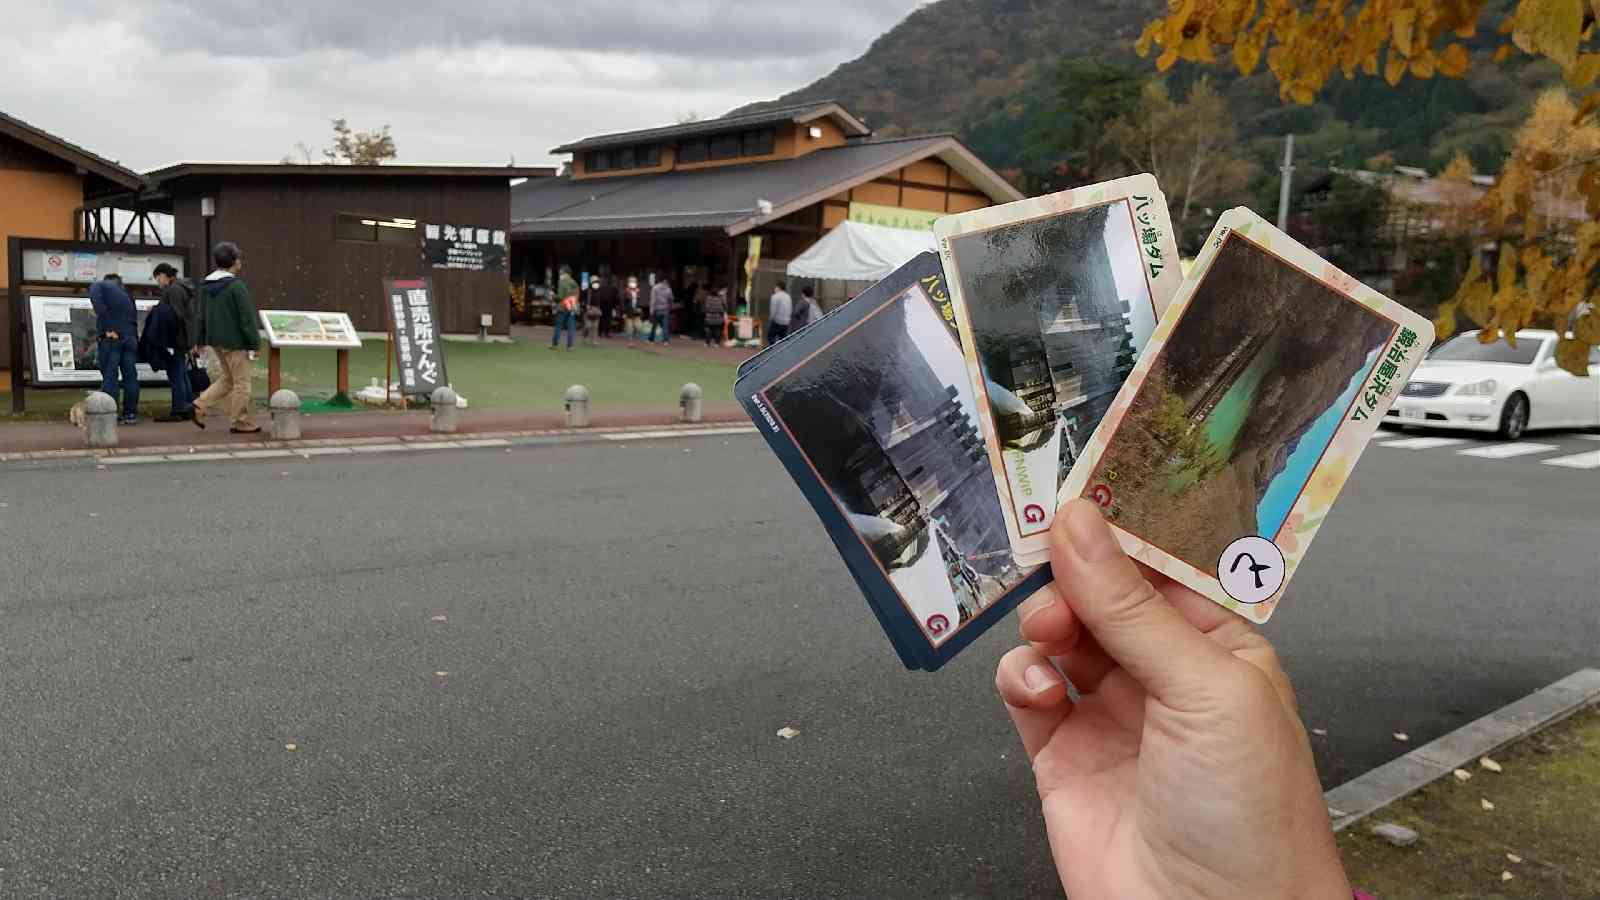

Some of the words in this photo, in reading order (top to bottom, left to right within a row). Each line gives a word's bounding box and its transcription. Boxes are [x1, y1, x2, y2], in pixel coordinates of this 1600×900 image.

[1133, 194, 1164, 279] 八ッ場ダム
[407, 289, 437, 384] 直売所てんぐ
[1091, 484, 1112, 508] G
[1024, 504, 1046, 524] G
[1229, 552, 1272, 589] と
[927, 614, 949, 635] G
